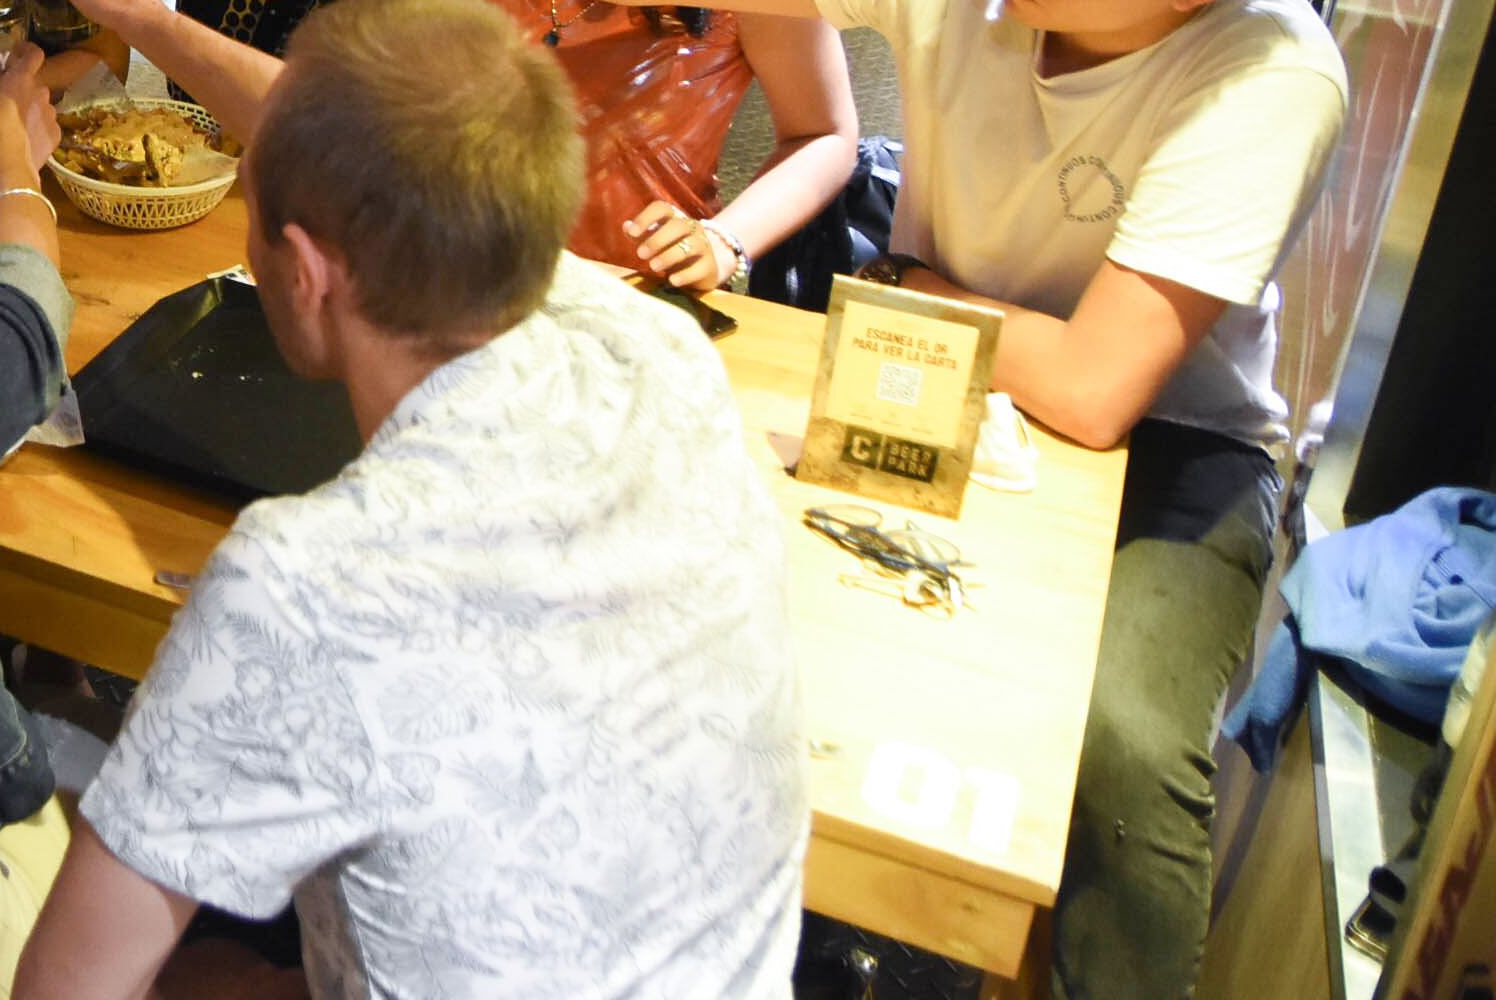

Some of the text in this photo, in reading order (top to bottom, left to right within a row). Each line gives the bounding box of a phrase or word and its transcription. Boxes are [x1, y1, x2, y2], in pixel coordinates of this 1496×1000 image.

[865, 327, 914, 347] ESCANEA
[917, 338, 929, 352] EL
[852, 336, 958, 370] PARA VER LA CARTA
[889, 442, 931, 464] BEER
[887, 455, 928, 478] PARK
